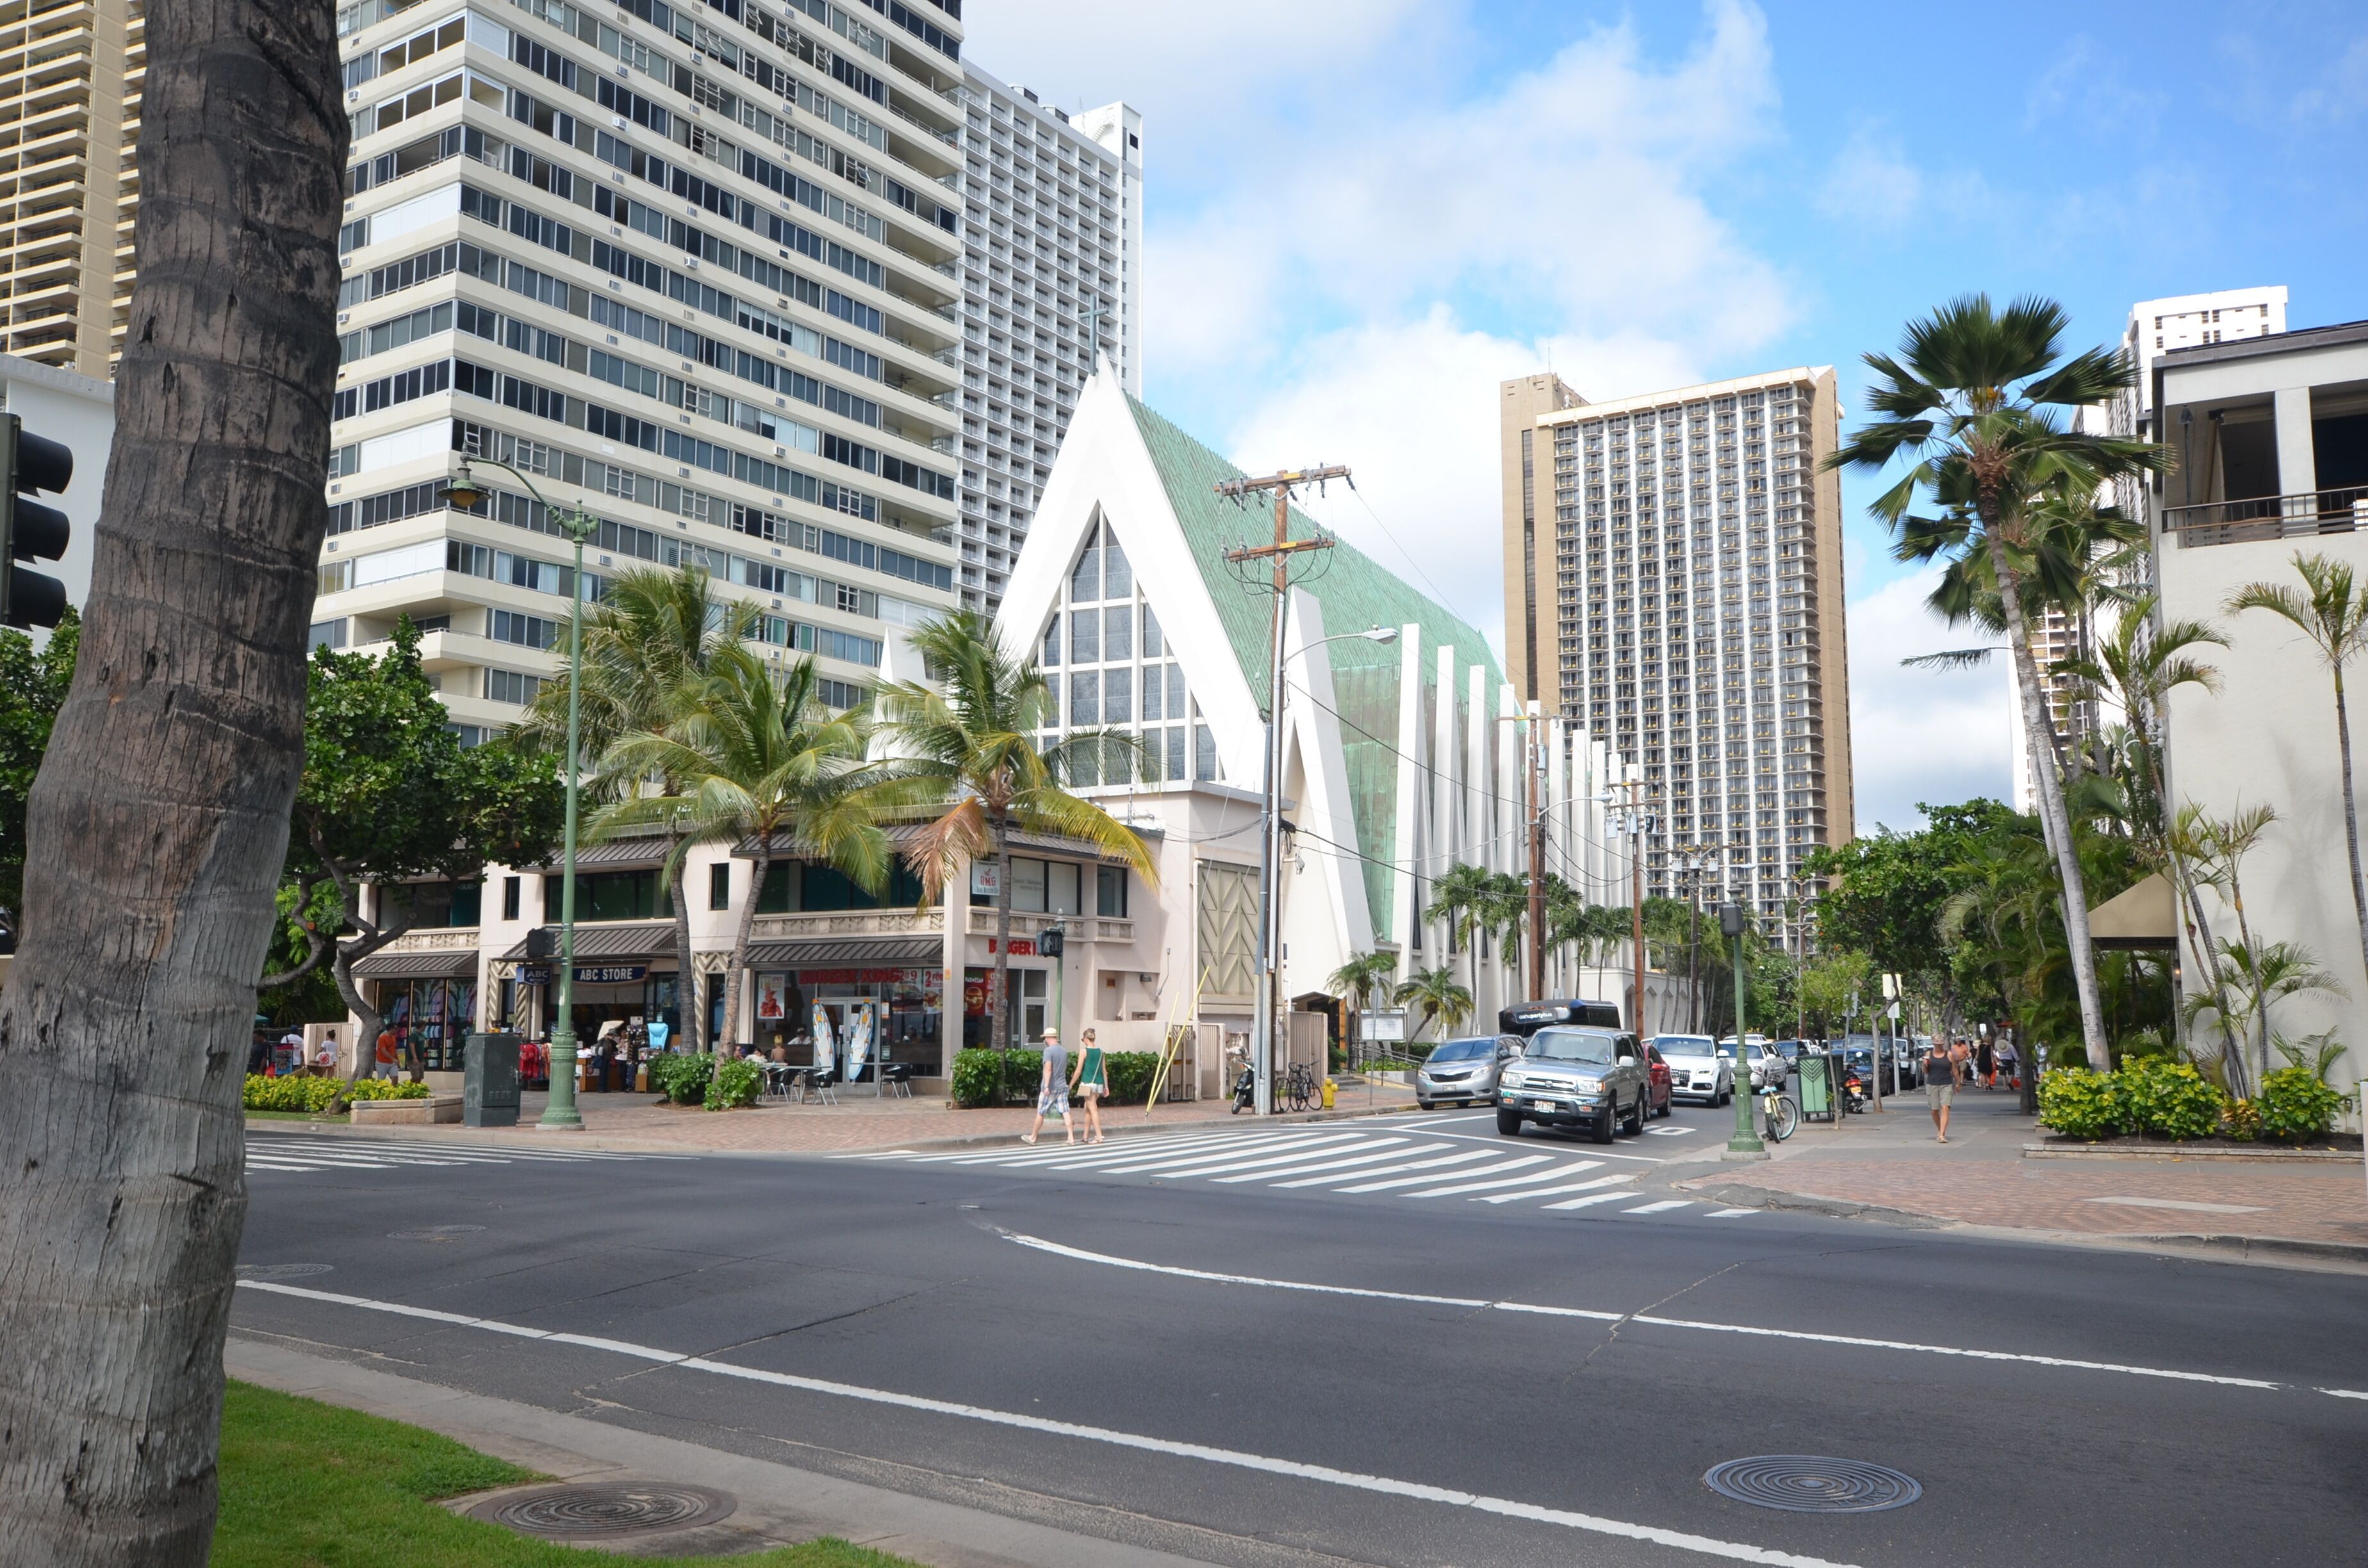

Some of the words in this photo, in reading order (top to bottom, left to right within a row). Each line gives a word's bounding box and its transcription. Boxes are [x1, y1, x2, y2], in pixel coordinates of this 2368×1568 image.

[980, 876, 996, 886] OMG
[527, 970, 548, 978] ABC
[580, 969, 598, 981] ABC
[602, 968, 633, 980] STORE
[799, 969, 856, 984] BURGER
[860, 968, 899, 983] KING
